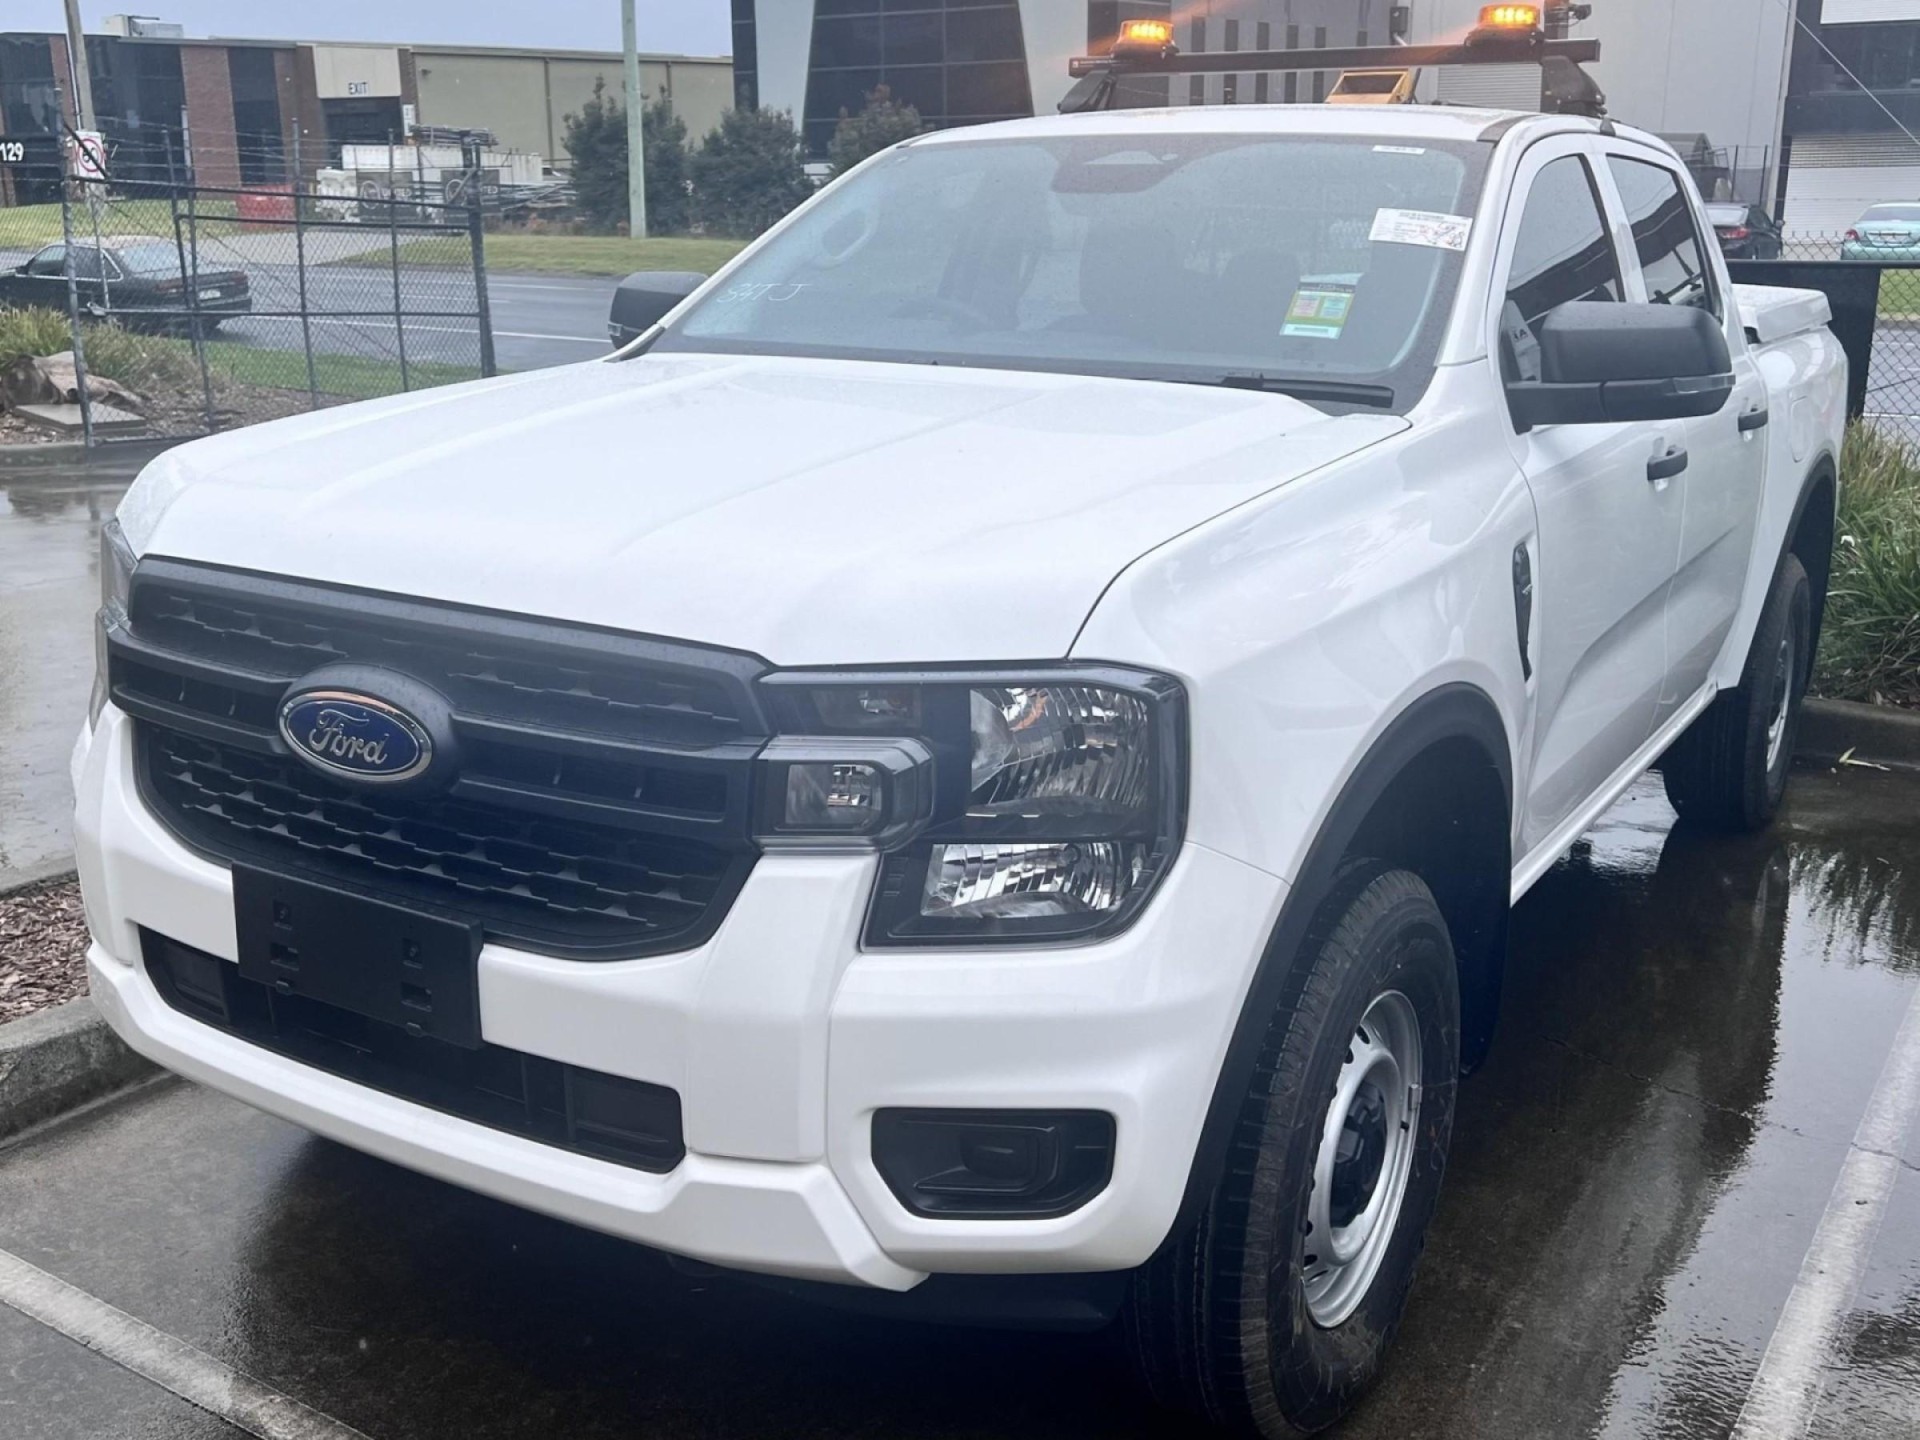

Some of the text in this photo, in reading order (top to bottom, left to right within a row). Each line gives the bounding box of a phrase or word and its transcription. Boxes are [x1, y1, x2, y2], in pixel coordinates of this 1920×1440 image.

[348, 82, 368, 95] EXIT
[0, 142, 24, 161] 129
[308, 709, 390, 765] Ford
